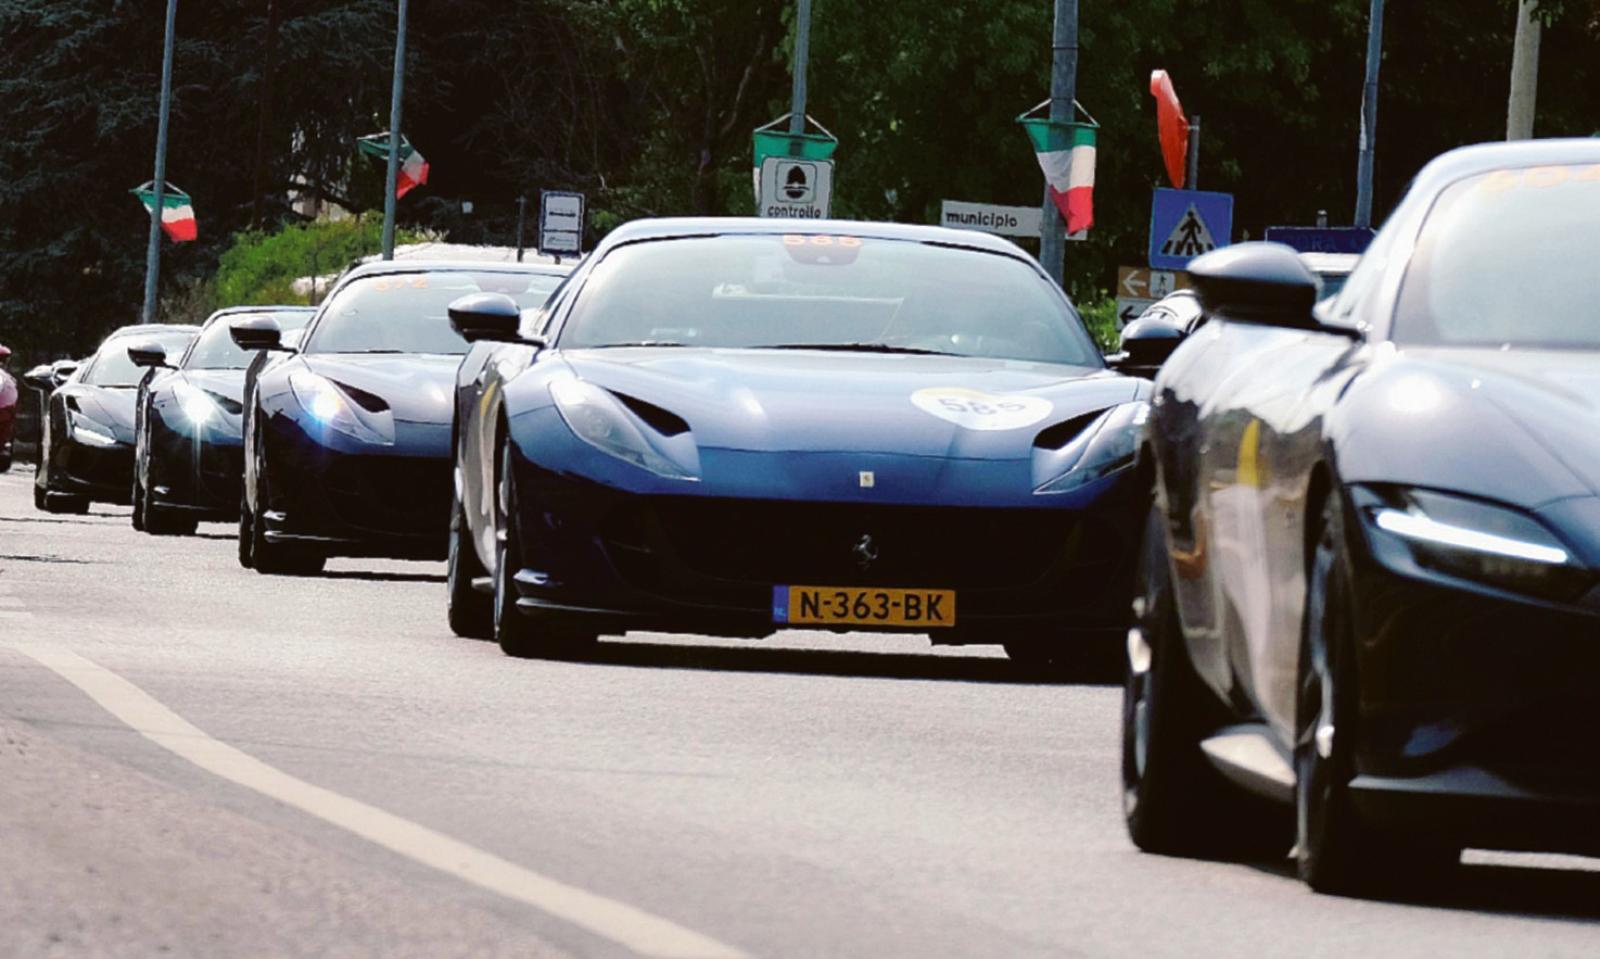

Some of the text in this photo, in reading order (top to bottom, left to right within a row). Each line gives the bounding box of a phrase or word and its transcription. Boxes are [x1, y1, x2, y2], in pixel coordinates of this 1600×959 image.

[767, 204, 822, 218] controllo
[946, 211, 1018, 229] municipio
[800, 591, 943, 621] N-363-BK
